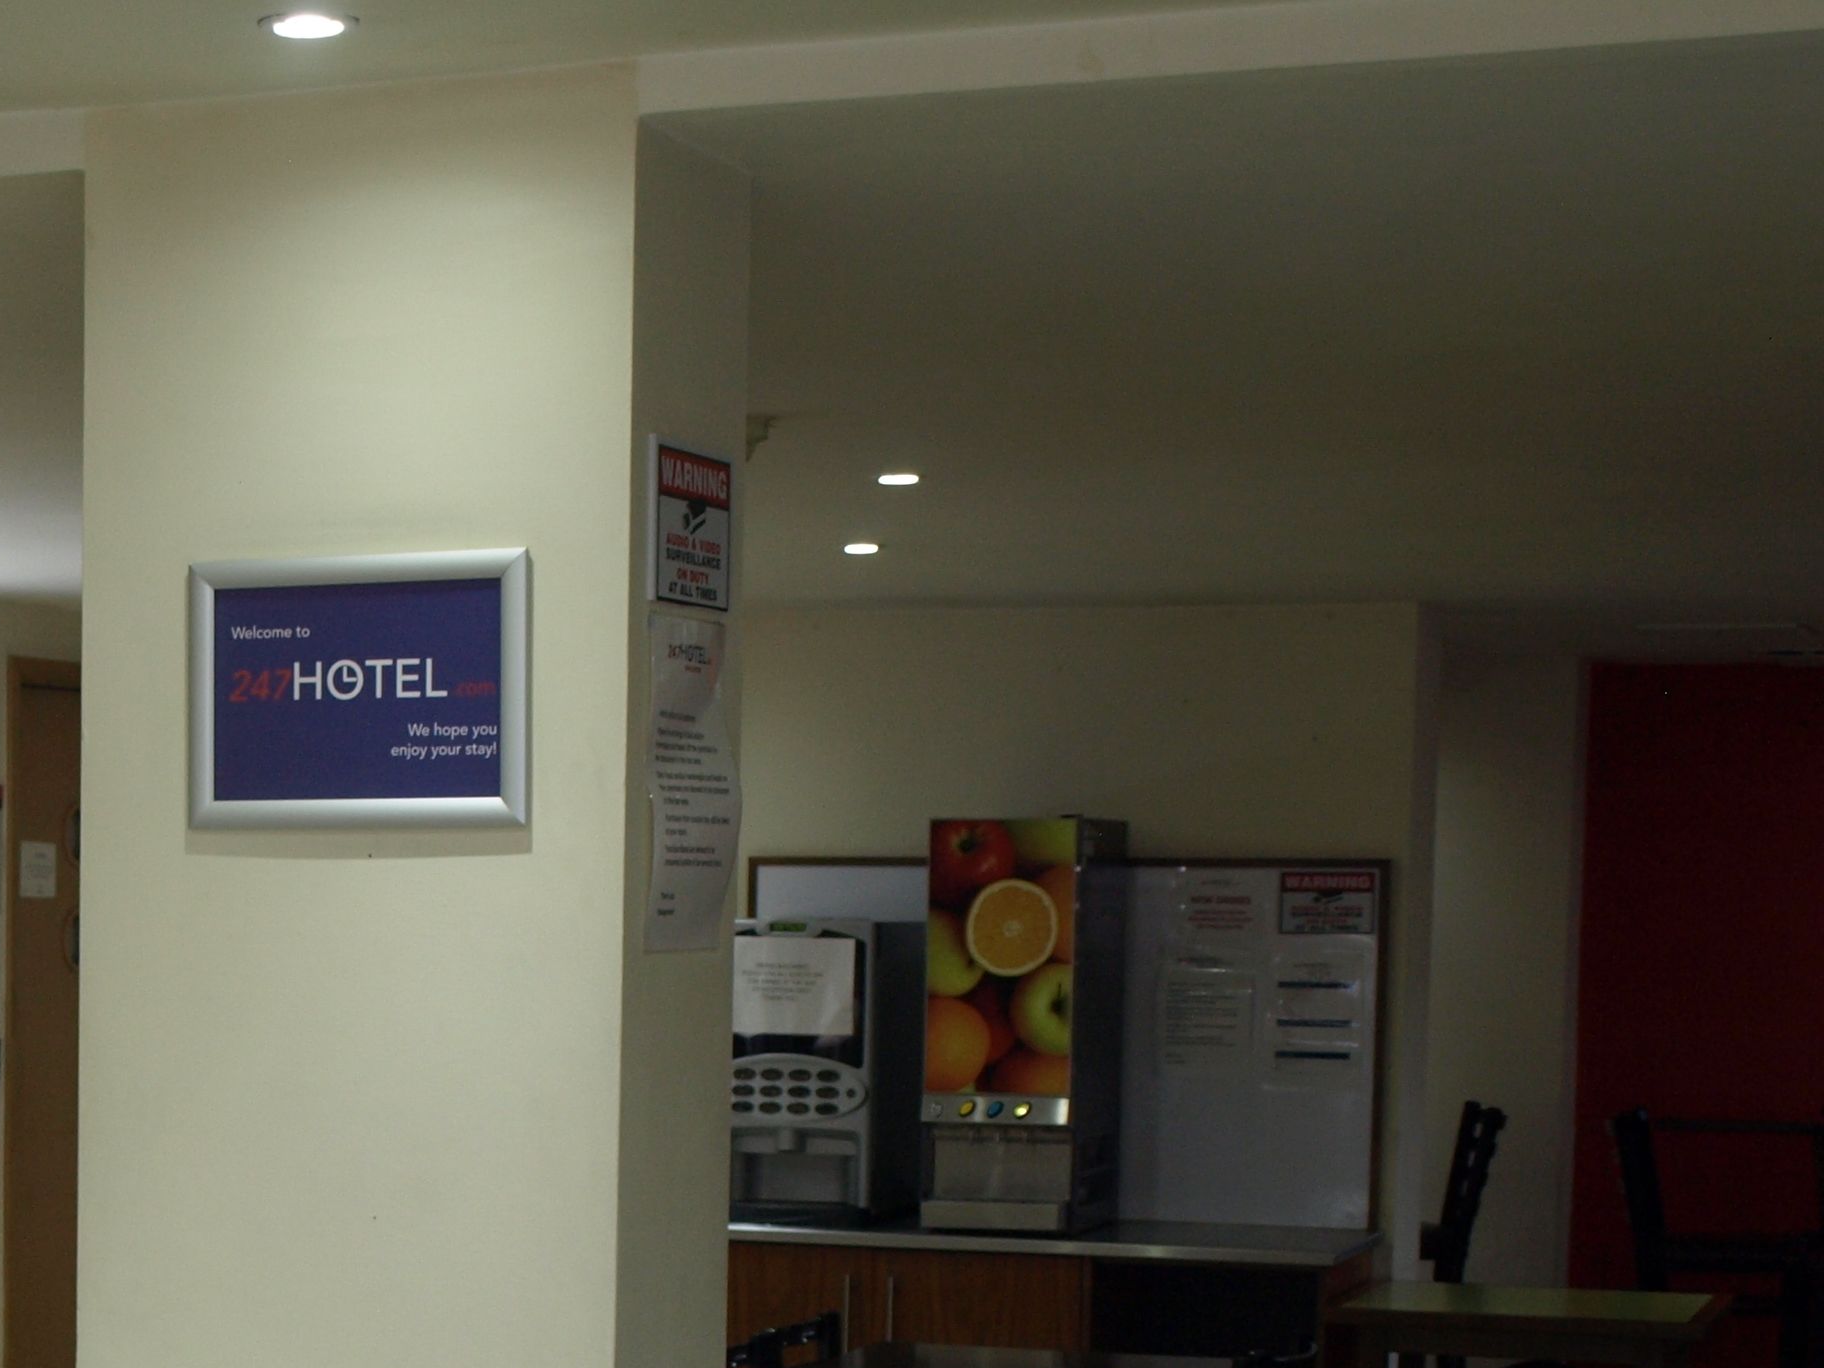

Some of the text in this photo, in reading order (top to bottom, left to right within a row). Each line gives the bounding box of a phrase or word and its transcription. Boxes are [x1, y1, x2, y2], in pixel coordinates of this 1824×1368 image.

[661, 455, 727, 499] WARNING
[231, 625, 310, 640] Welcome to
[408, 722, 497, 740] We hope you
[391, 742, 497, 759] enjoy your stay!
